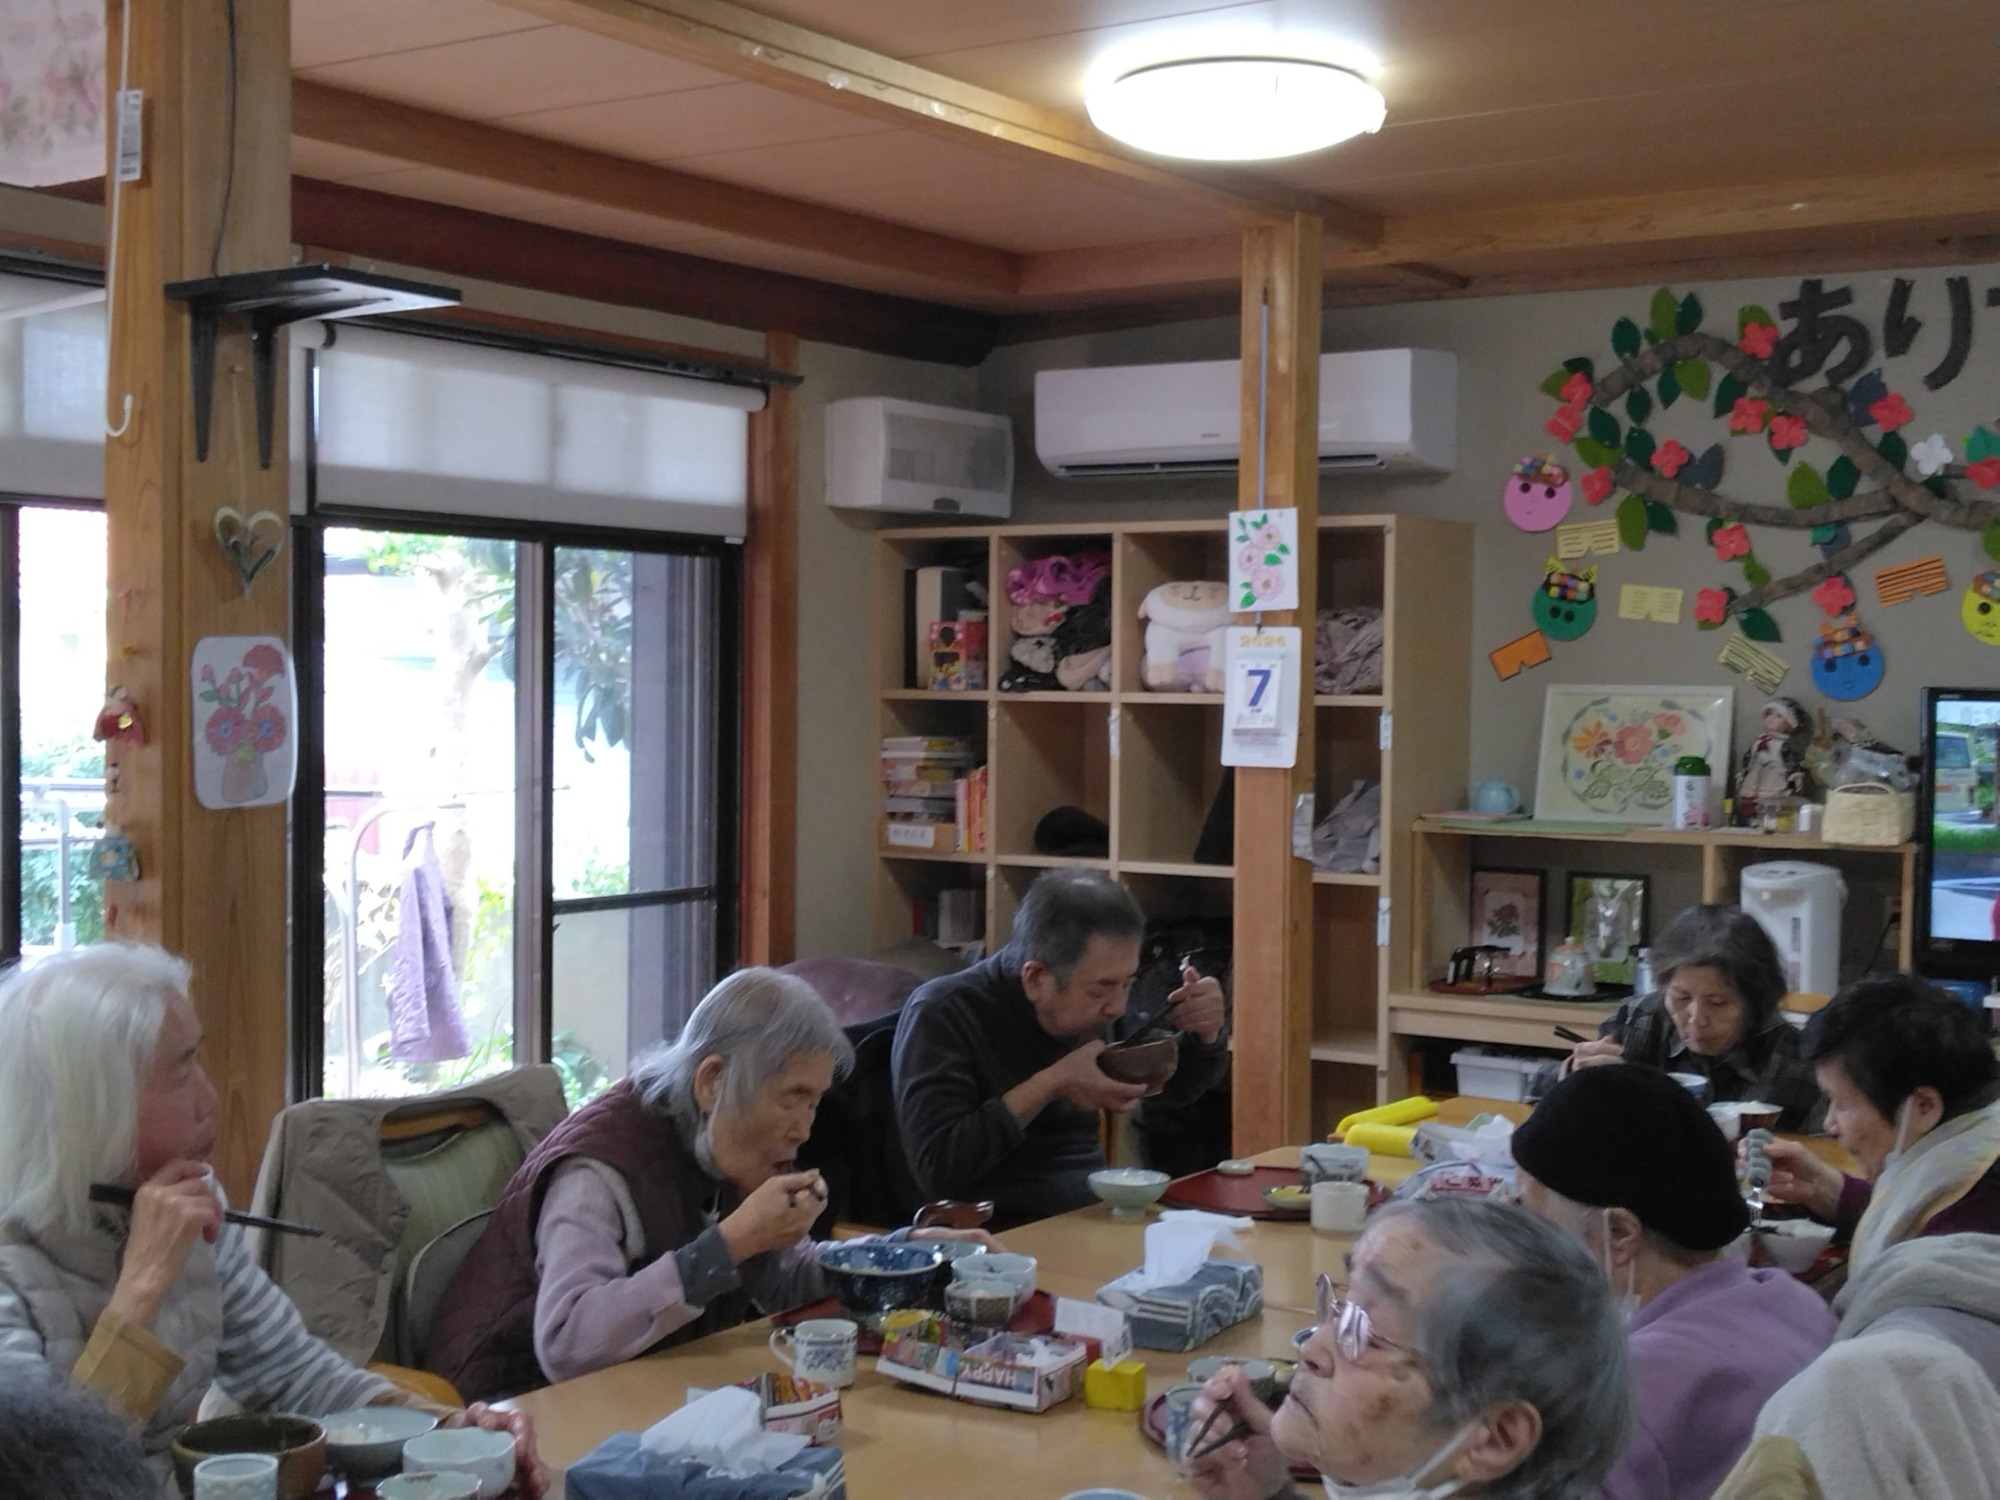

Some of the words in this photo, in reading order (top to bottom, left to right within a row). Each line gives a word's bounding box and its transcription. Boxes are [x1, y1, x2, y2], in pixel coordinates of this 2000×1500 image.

[1769, 276, 2000, 391] あり
[1246, 669, 1272, 707] 7
[963, 1363, 1017, 1387] HAPPY
